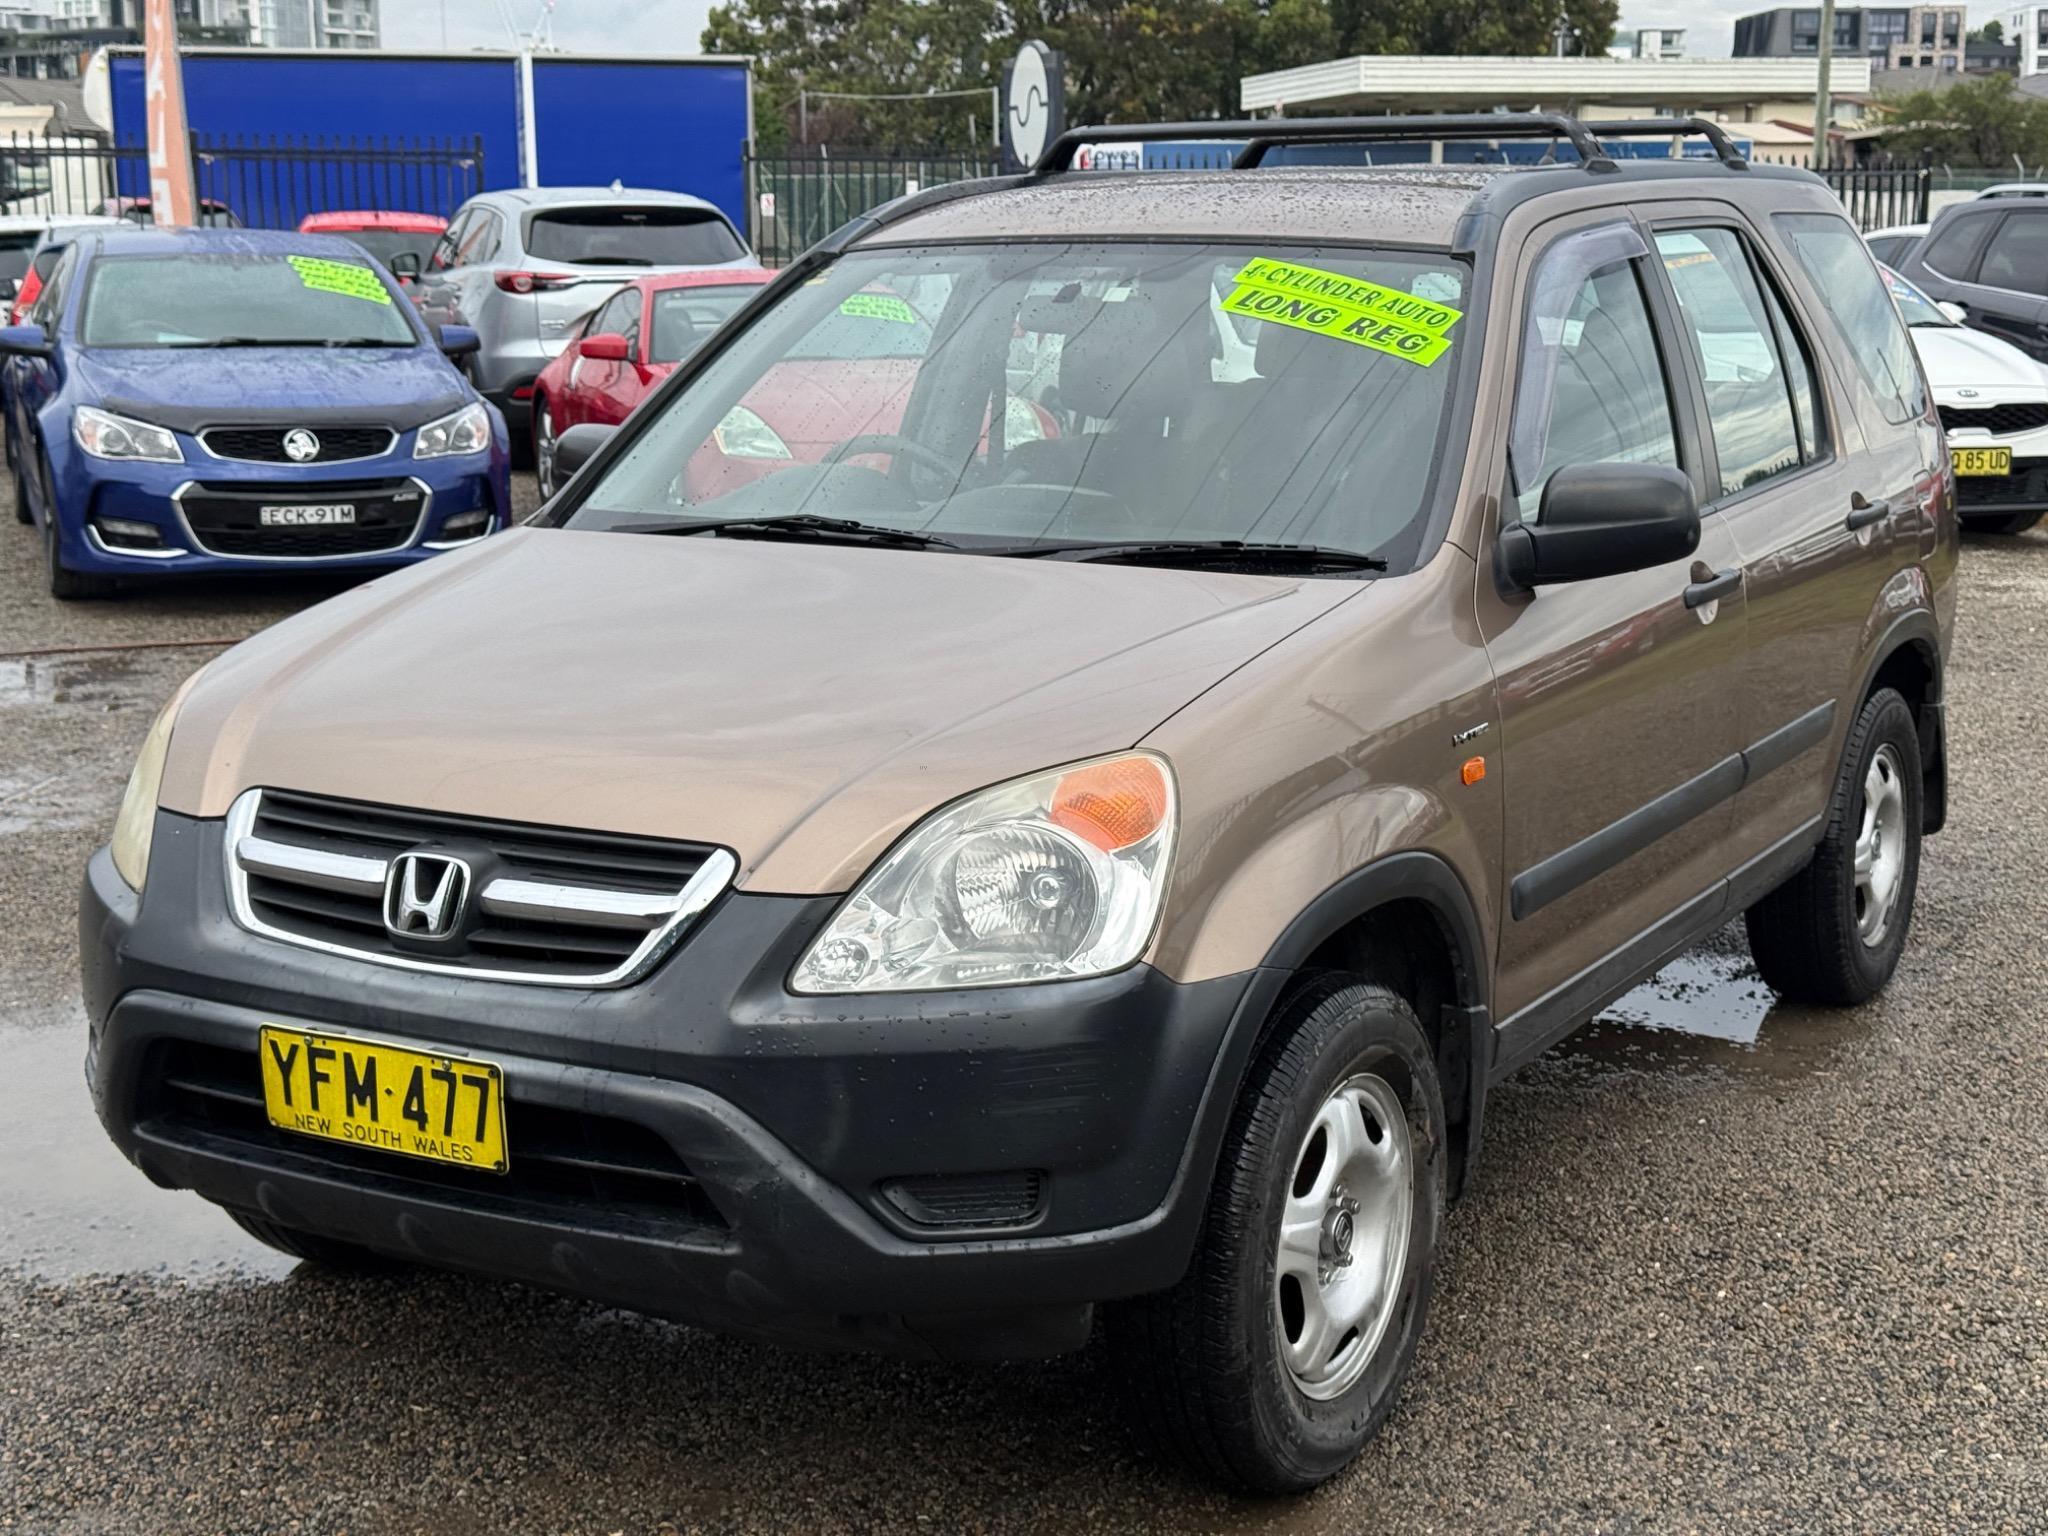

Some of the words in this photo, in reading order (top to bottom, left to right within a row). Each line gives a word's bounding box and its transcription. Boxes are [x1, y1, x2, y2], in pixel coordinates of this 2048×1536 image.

[1234, 290, 1342, 327] LONG
[1343, 316, 1434, 354] REG
[1242, 264, 1385, 306] 4-CYLINDER
[1381, 298, 1450, 328] AUTO
[1965, 451, 1985, 469] 85
[1989, 451, 2009, 469] UD
[295, 1113, 331, 1134] NEW
[343, 1123, 401, 1145] SOUTH
[413, 1136, 474, 1161] WALES
